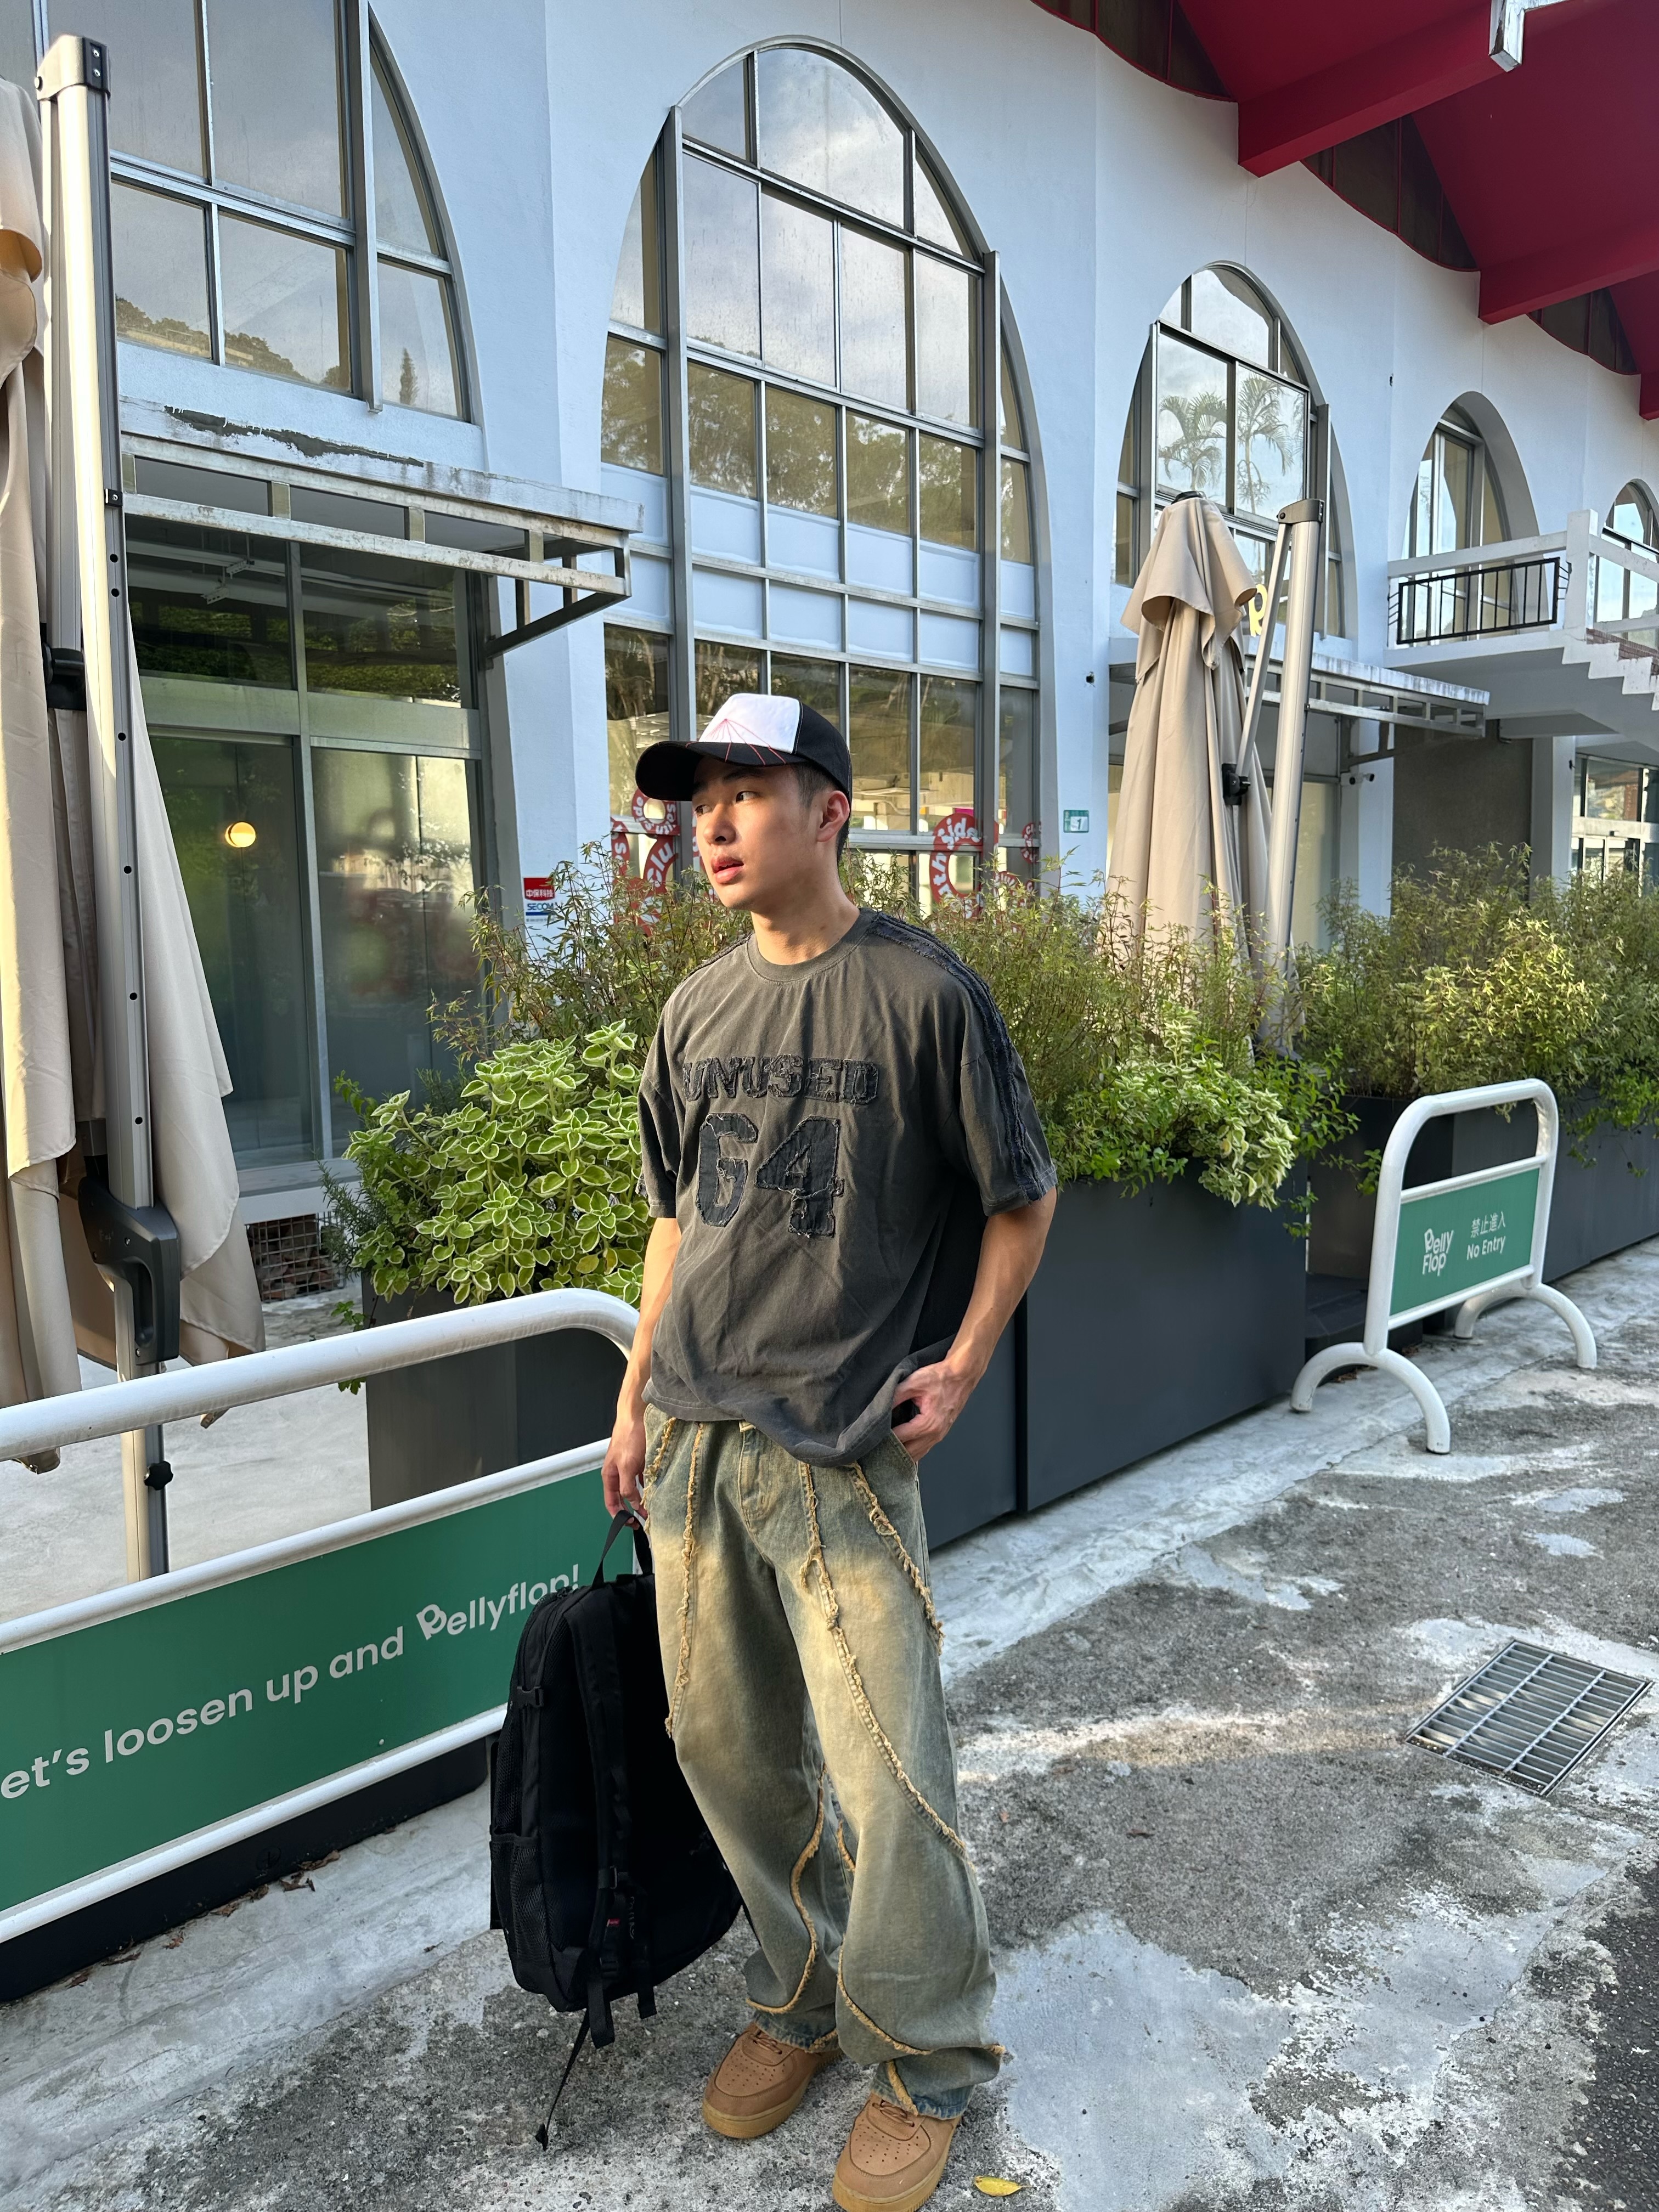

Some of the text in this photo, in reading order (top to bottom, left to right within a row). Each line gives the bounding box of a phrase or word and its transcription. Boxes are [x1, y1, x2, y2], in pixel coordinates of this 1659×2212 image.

[682, 1054, 878, 1105] UNUSED
[696, 1113, 844, 1238] 64
[1470, 1211, 1506, 1238] 禁止進入
[1422, 1252, 1447, 1277] Flop
[1466, 1235, 1506, 1260] No Entry
[1, 1747, 89, 1799] et's
[104, 1688, 253, 1763] loosen
[266, 1665, 319, 1704] up
[329, 1626, 403, 1679] and
